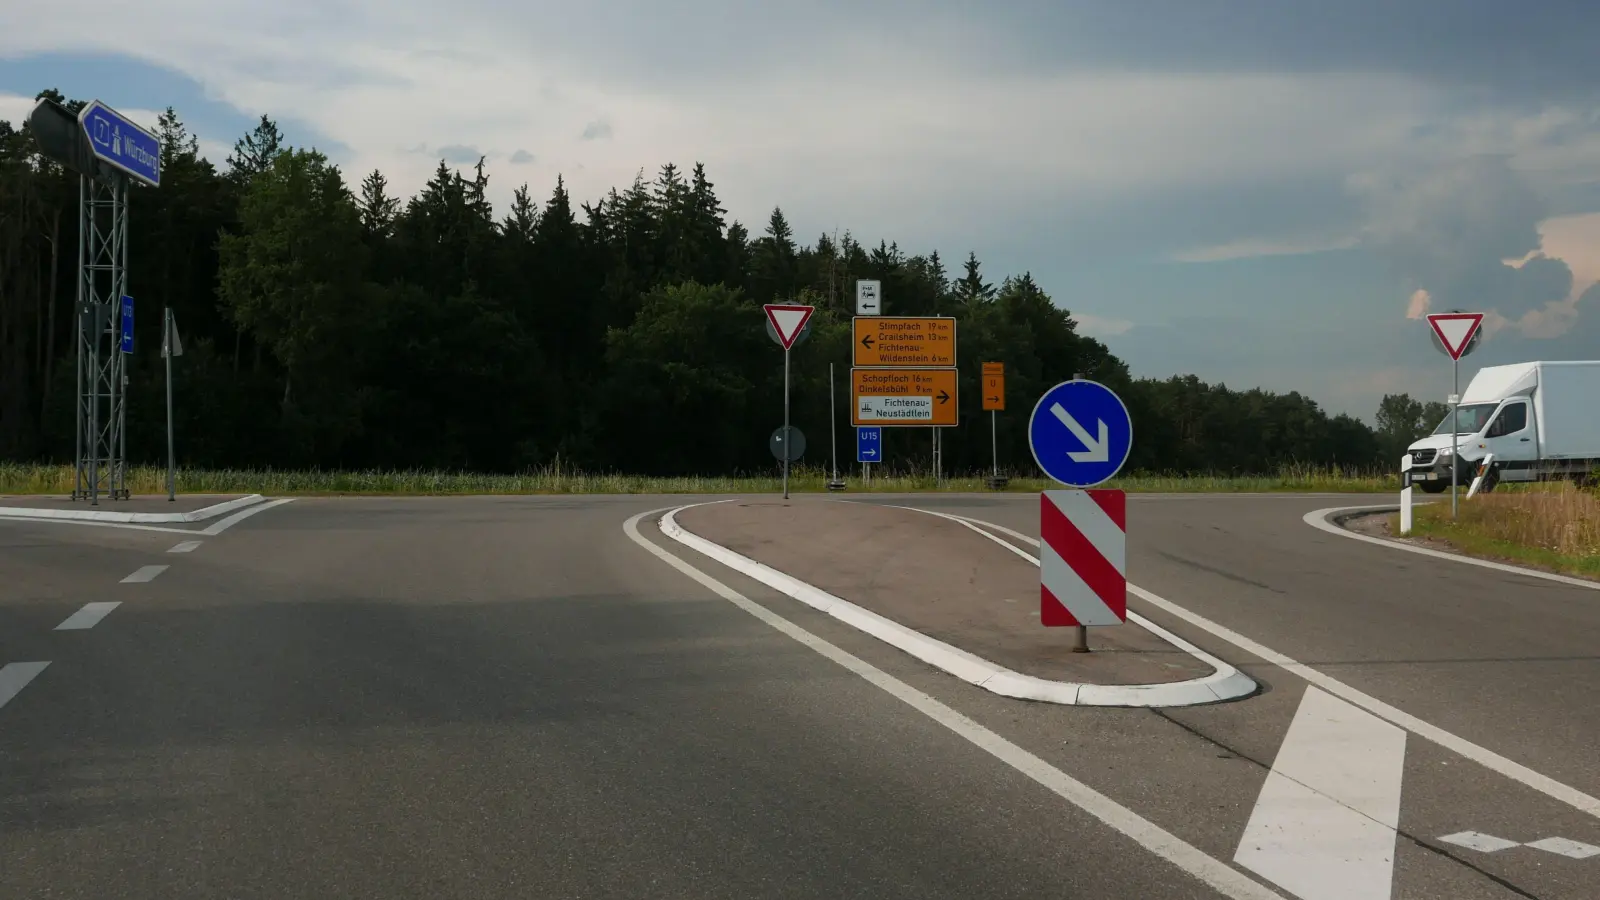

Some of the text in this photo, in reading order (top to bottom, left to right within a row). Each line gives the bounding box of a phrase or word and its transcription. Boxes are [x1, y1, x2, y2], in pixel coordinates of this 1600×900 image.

[99, 123, 104, 139] 7
[124, 135, 157, 175] Würzburg
[879, 322, 921, 331] Stimpfach
[928, 322, 937, 330] 19
[878, 333, 924, 341] Crailsheim
[928, 333, 937, 341] 13
[878, 343, 925, 352] Fichtenau-
[879, 354, 929, 362] Wildenstein
[931, 354, 937, 362] 6
[862, 374, 933, 384] Schopfloch 16 km
[859, 385, 909, 393] Dinkelsbühl
[915, 385, 921, 393] 9
[884, 398, 930, 407] Fichtenau-
[876, 409, 930, 418] Neustädtlein
[861, 431, 878, 440] U15
